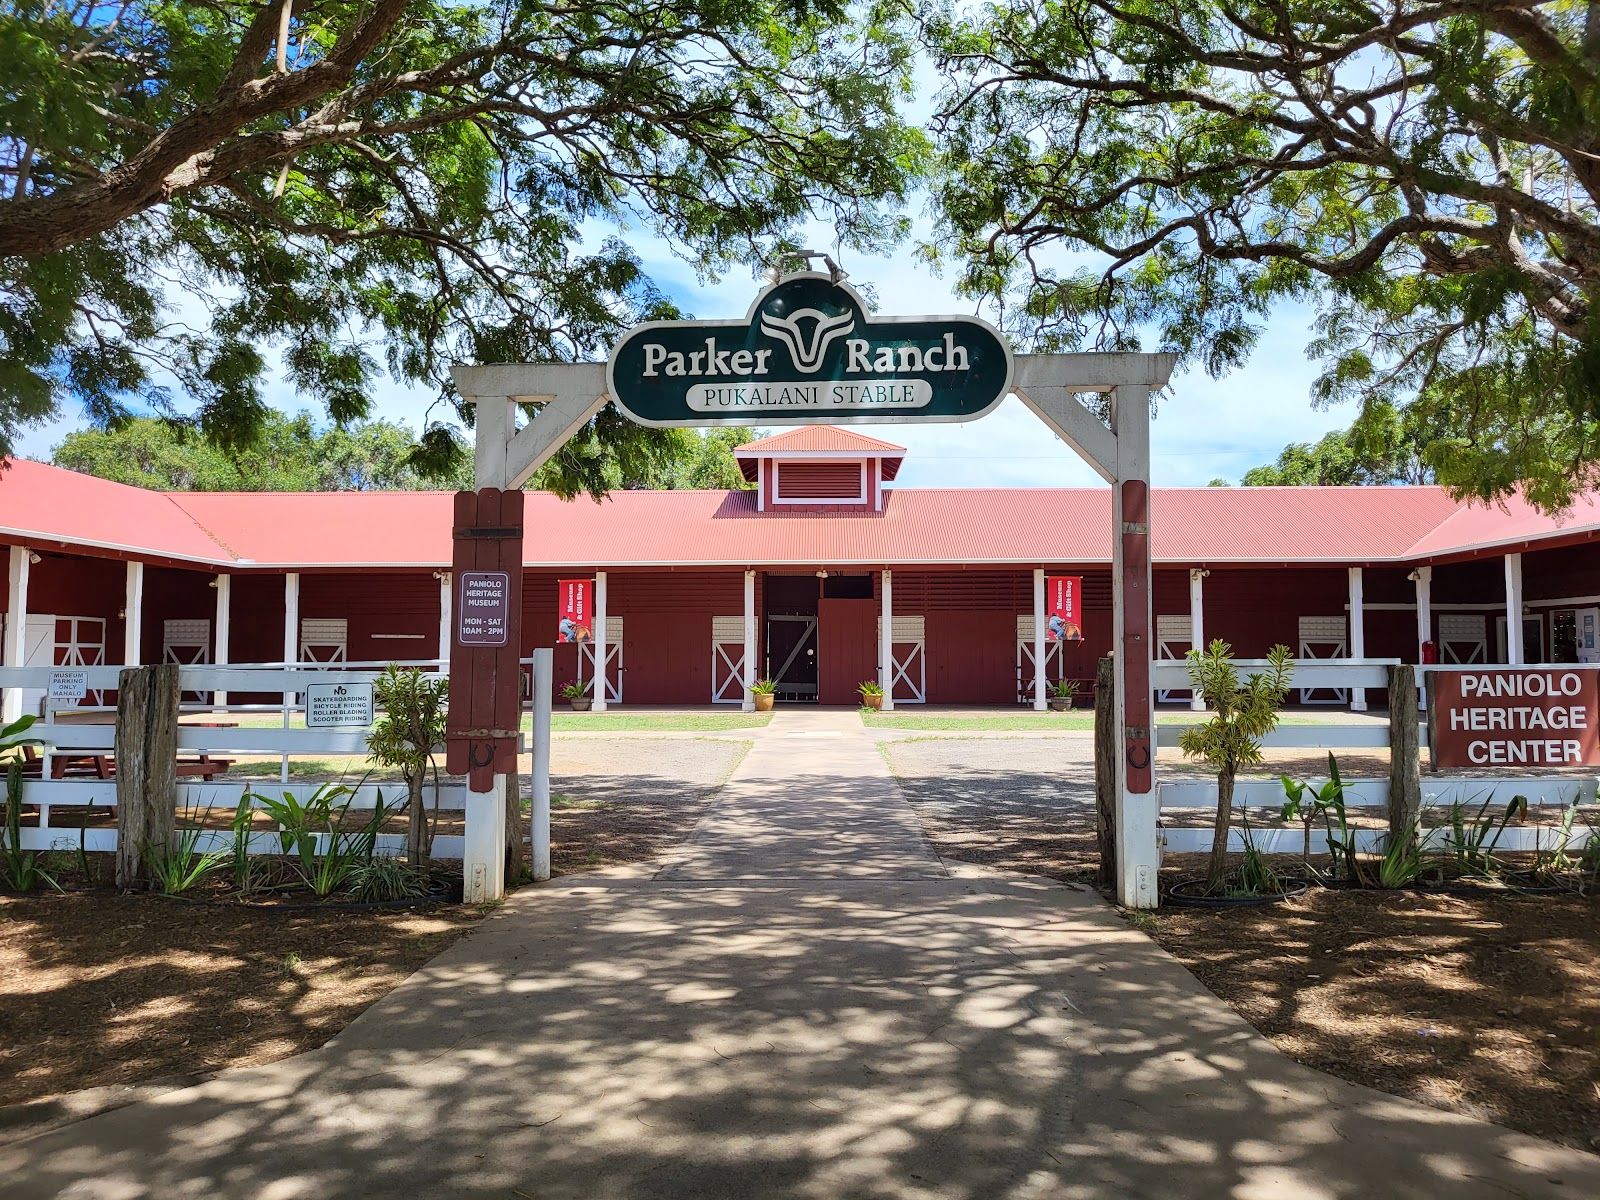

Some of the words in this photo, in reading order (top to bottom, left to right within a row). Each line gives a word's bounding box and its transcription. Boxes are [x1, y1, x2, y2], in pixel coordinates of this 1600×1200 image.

[642, 337, 772, 377] Parker
[846, 333, 970, 373] Ranch
[704, 386, 818, 406] PUKALANI
[832, 384, 914, 404] STABLE
[333, 688, 347, 696] NO
[1460, 672, 1582, 698] PANIOLO
[1450, 706, 1588, 731] HERITAGE
[1467, 739, 1583, 764] CENTER
